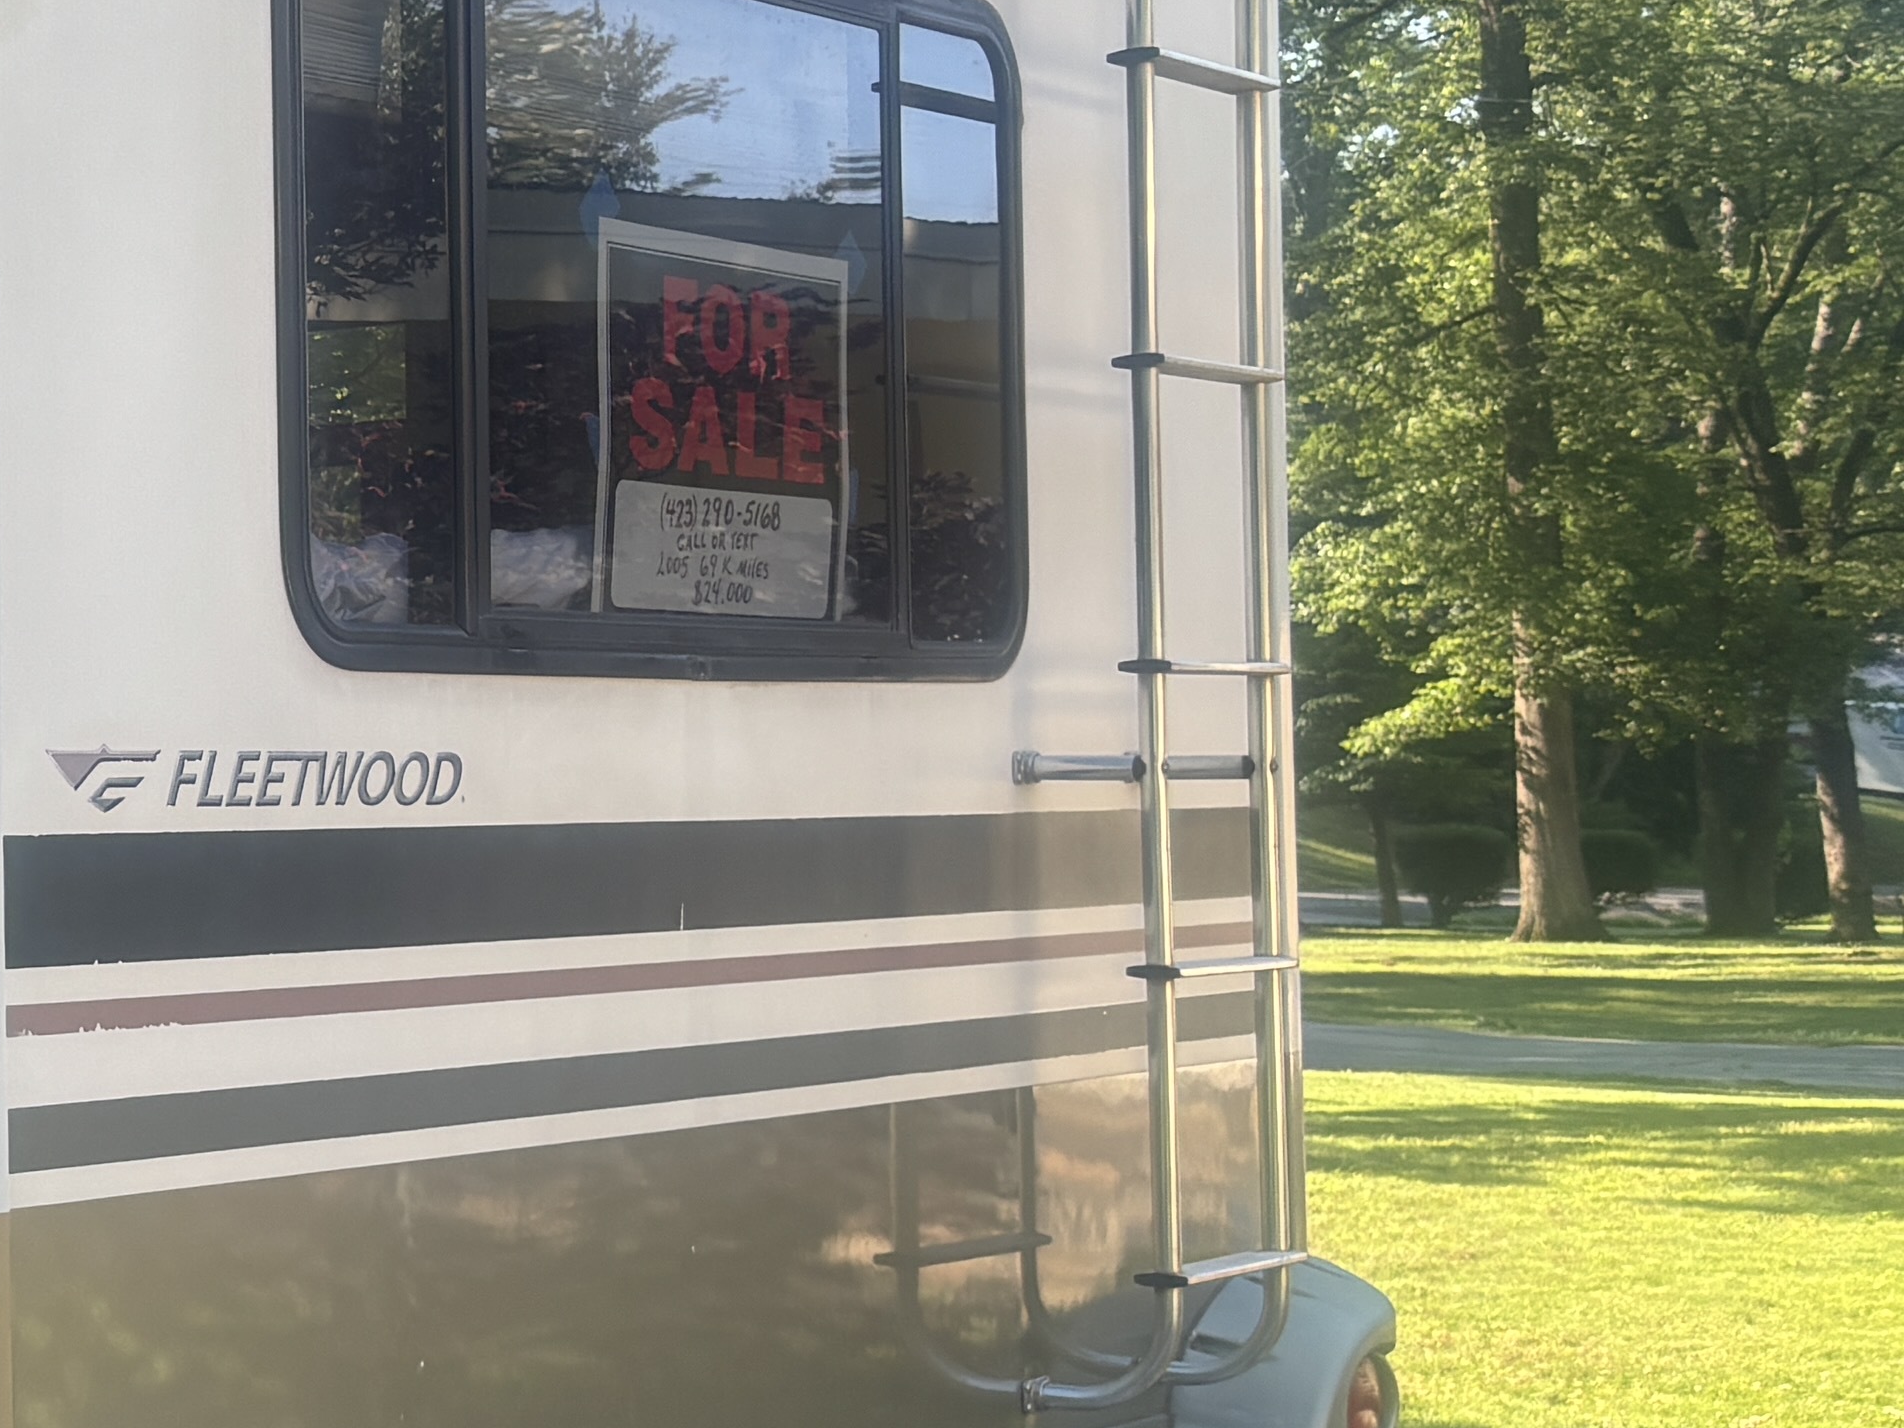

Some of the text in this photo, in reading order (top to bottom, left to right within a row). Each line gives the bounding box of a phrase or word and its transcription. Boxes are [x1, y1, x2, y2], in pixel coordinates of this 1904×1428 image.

[662, 274, 792, 381] FOR
[628, 376, 825, 485] SALE
[660, 492, 698, 532] (423)
[676, 532, 759, 552] CALL OR TEXT
[699, 554, 718, 578] 69
[166, 750, 463, 807] FLEETWOOD
